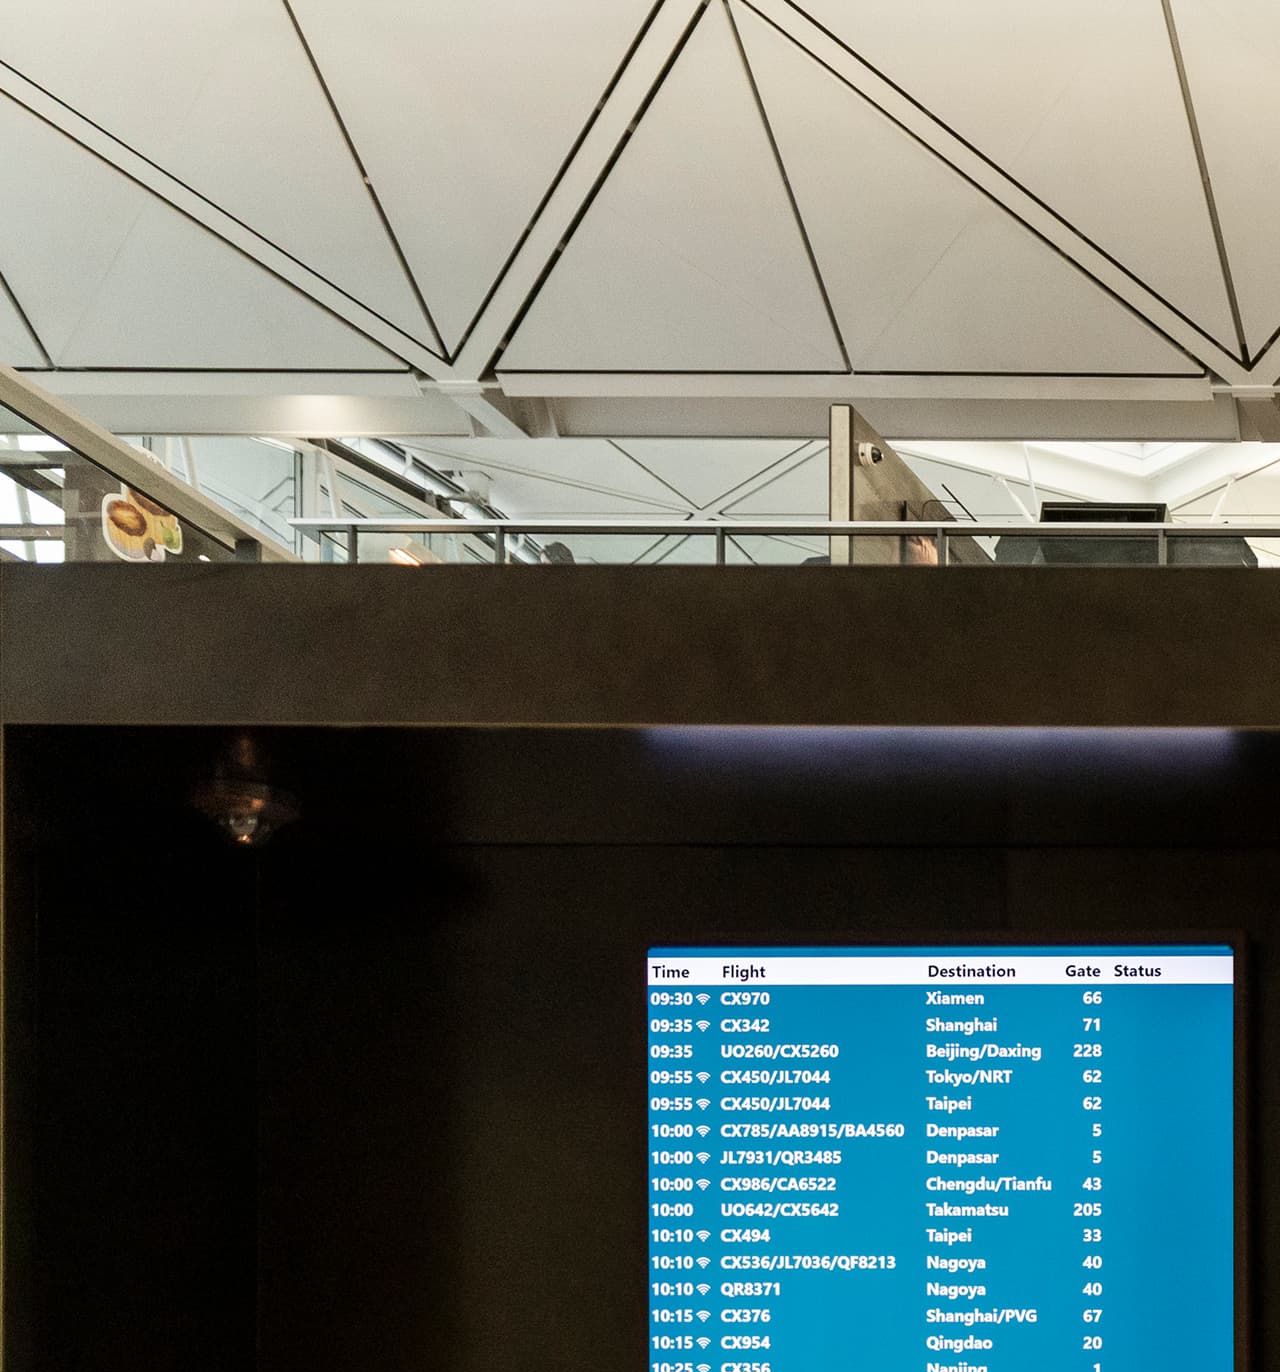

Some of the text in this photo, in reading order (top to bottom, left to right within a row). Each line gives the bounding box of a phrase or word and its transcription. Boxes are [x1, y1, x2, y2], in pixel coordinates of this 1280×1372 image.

[652, 964, 1161, 981] Time Flight Destination Gate Status
[651, 991, 1102, 1005] 09:30 CX970 Xiamen 66
[650, 1017, 1100, 1035] 09:35 CX342 Shanghai 71
[650, 1043, 1102, 1061] 09:35 UO260/CX5260 Beijing/Daxing 228
[650, 1069, 1101, 1087] 09:55 CX450/JL7044 Tokyo/NRT 62
[651, 1096, 1101, 1114] 09:55 CX450/JL7044 Taipei 62
[652, 1124, 1101, 1140] 10:00 CX785/AA8915/BA4560 Denpasar 5
[652, 1150, 1102, 1167] 10:00 JL7931/QR3485 Denpasar 5
[652, 1176, 1101, 1194] 10:00 CX986/CA6522 Chengdu/Tianfu 43
[652, 1202, 1101, 1218] 10:00 UO642/CX5642 Takamatsu 205
[652, 1228, 1101, 1246] 10:10 CX494 Taipei 33
[652, 1256, 1102, 1272] 10:10 CX536/JL7036/QF8213 Nagoya 40
[652, 1282, 1102, 1299] 10:10 QR8371 Nagoya 40
[652, 1308, 1102, 1326] 10:15 CX376 Shanghai/PVG 67
[652, 1335, 1102, 1353] 10:15 CX954 Qingdao 20
